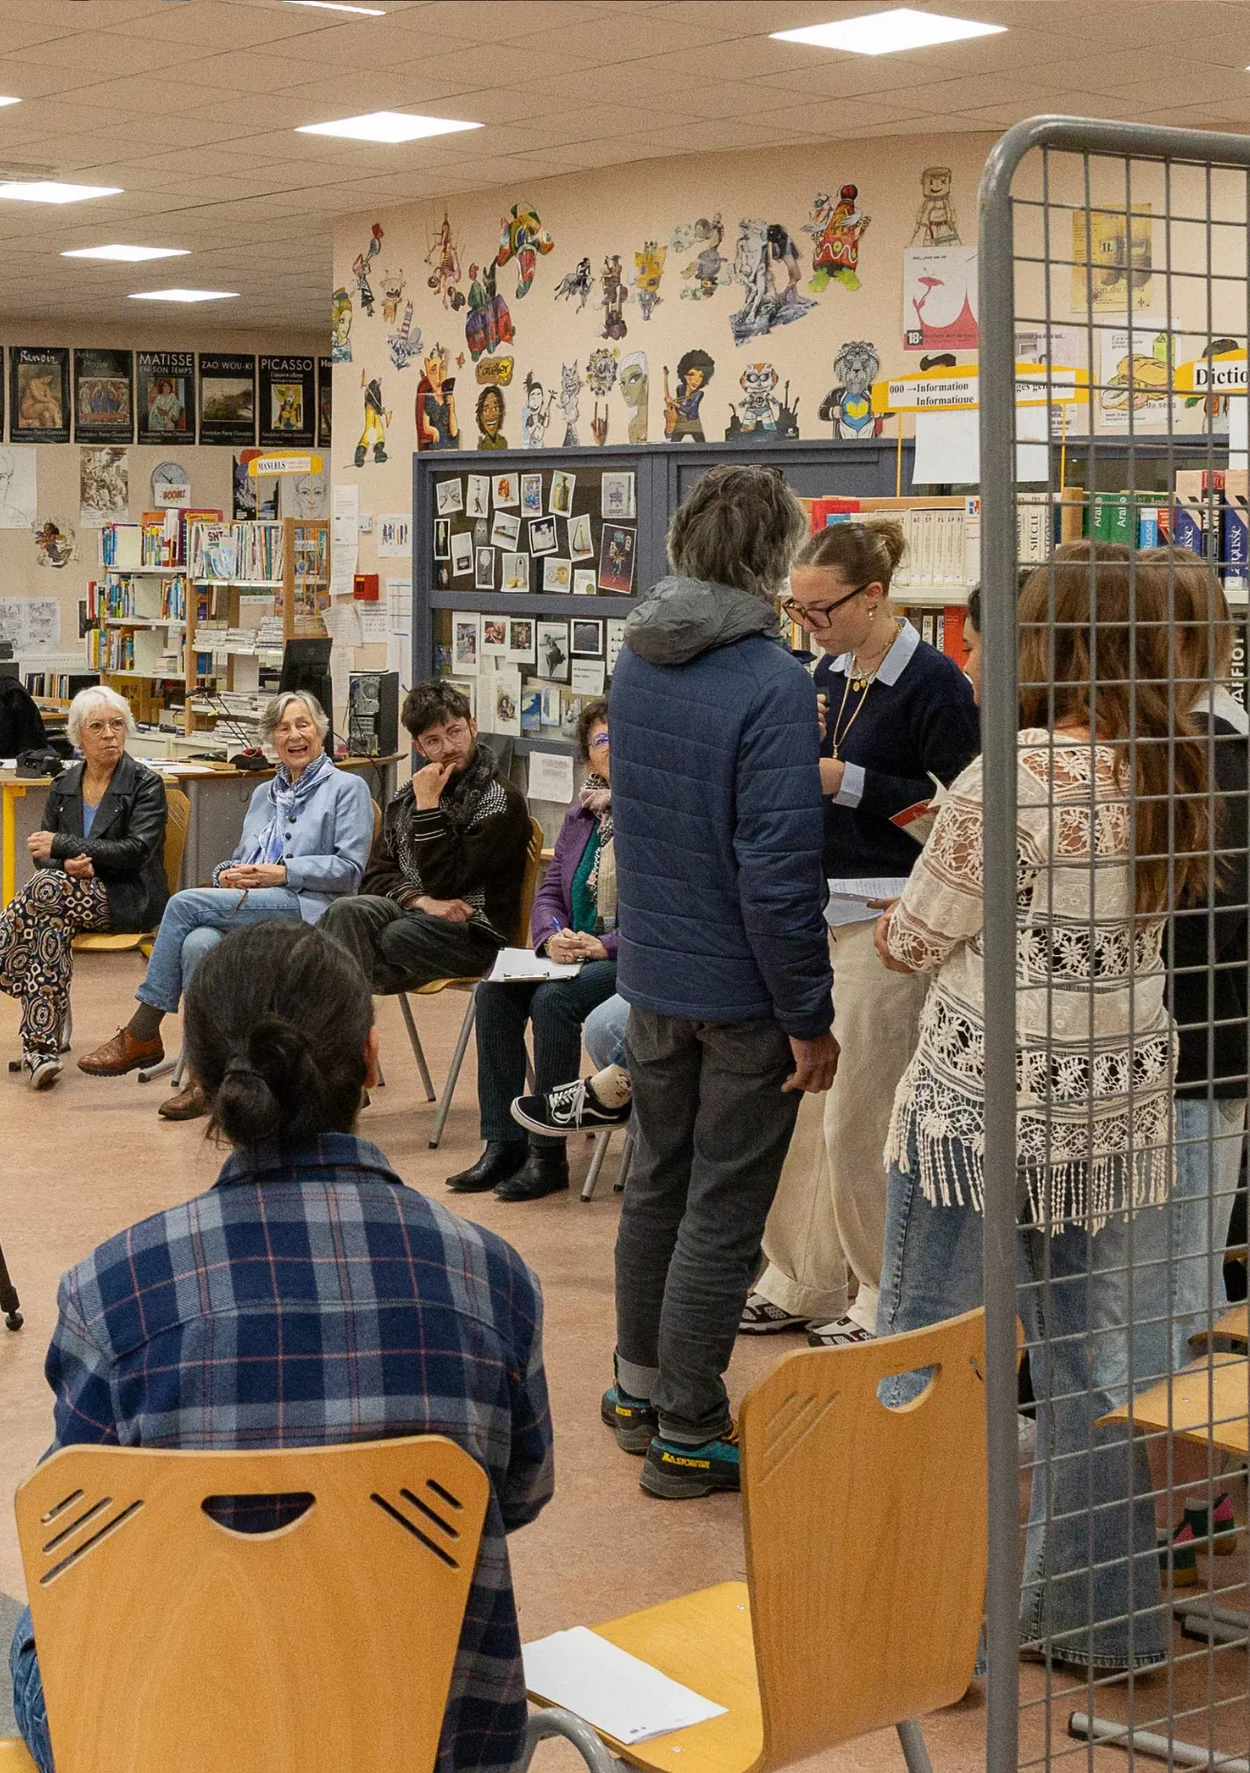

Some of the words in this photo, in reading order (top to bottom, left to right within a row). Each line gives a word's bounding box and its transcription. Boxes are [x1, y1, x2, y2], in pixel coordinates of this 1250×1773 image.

[20, 350, 59, 365] Renoir
[139, 353, 193, 366] MATISSE
[202, 360, 218, 369] ZAO
[222, 361, 253, 370] WOU-KI
[261, 359, 312, 371] PICASSO
[889, 385, 904, 394] 000
[916, 382, 969, 393] Information
[916, 395, 974, 406] Informatique
[258, 461, 286, 470] MANUELS
[1212, 494, 1221, 533] HARAP'S
